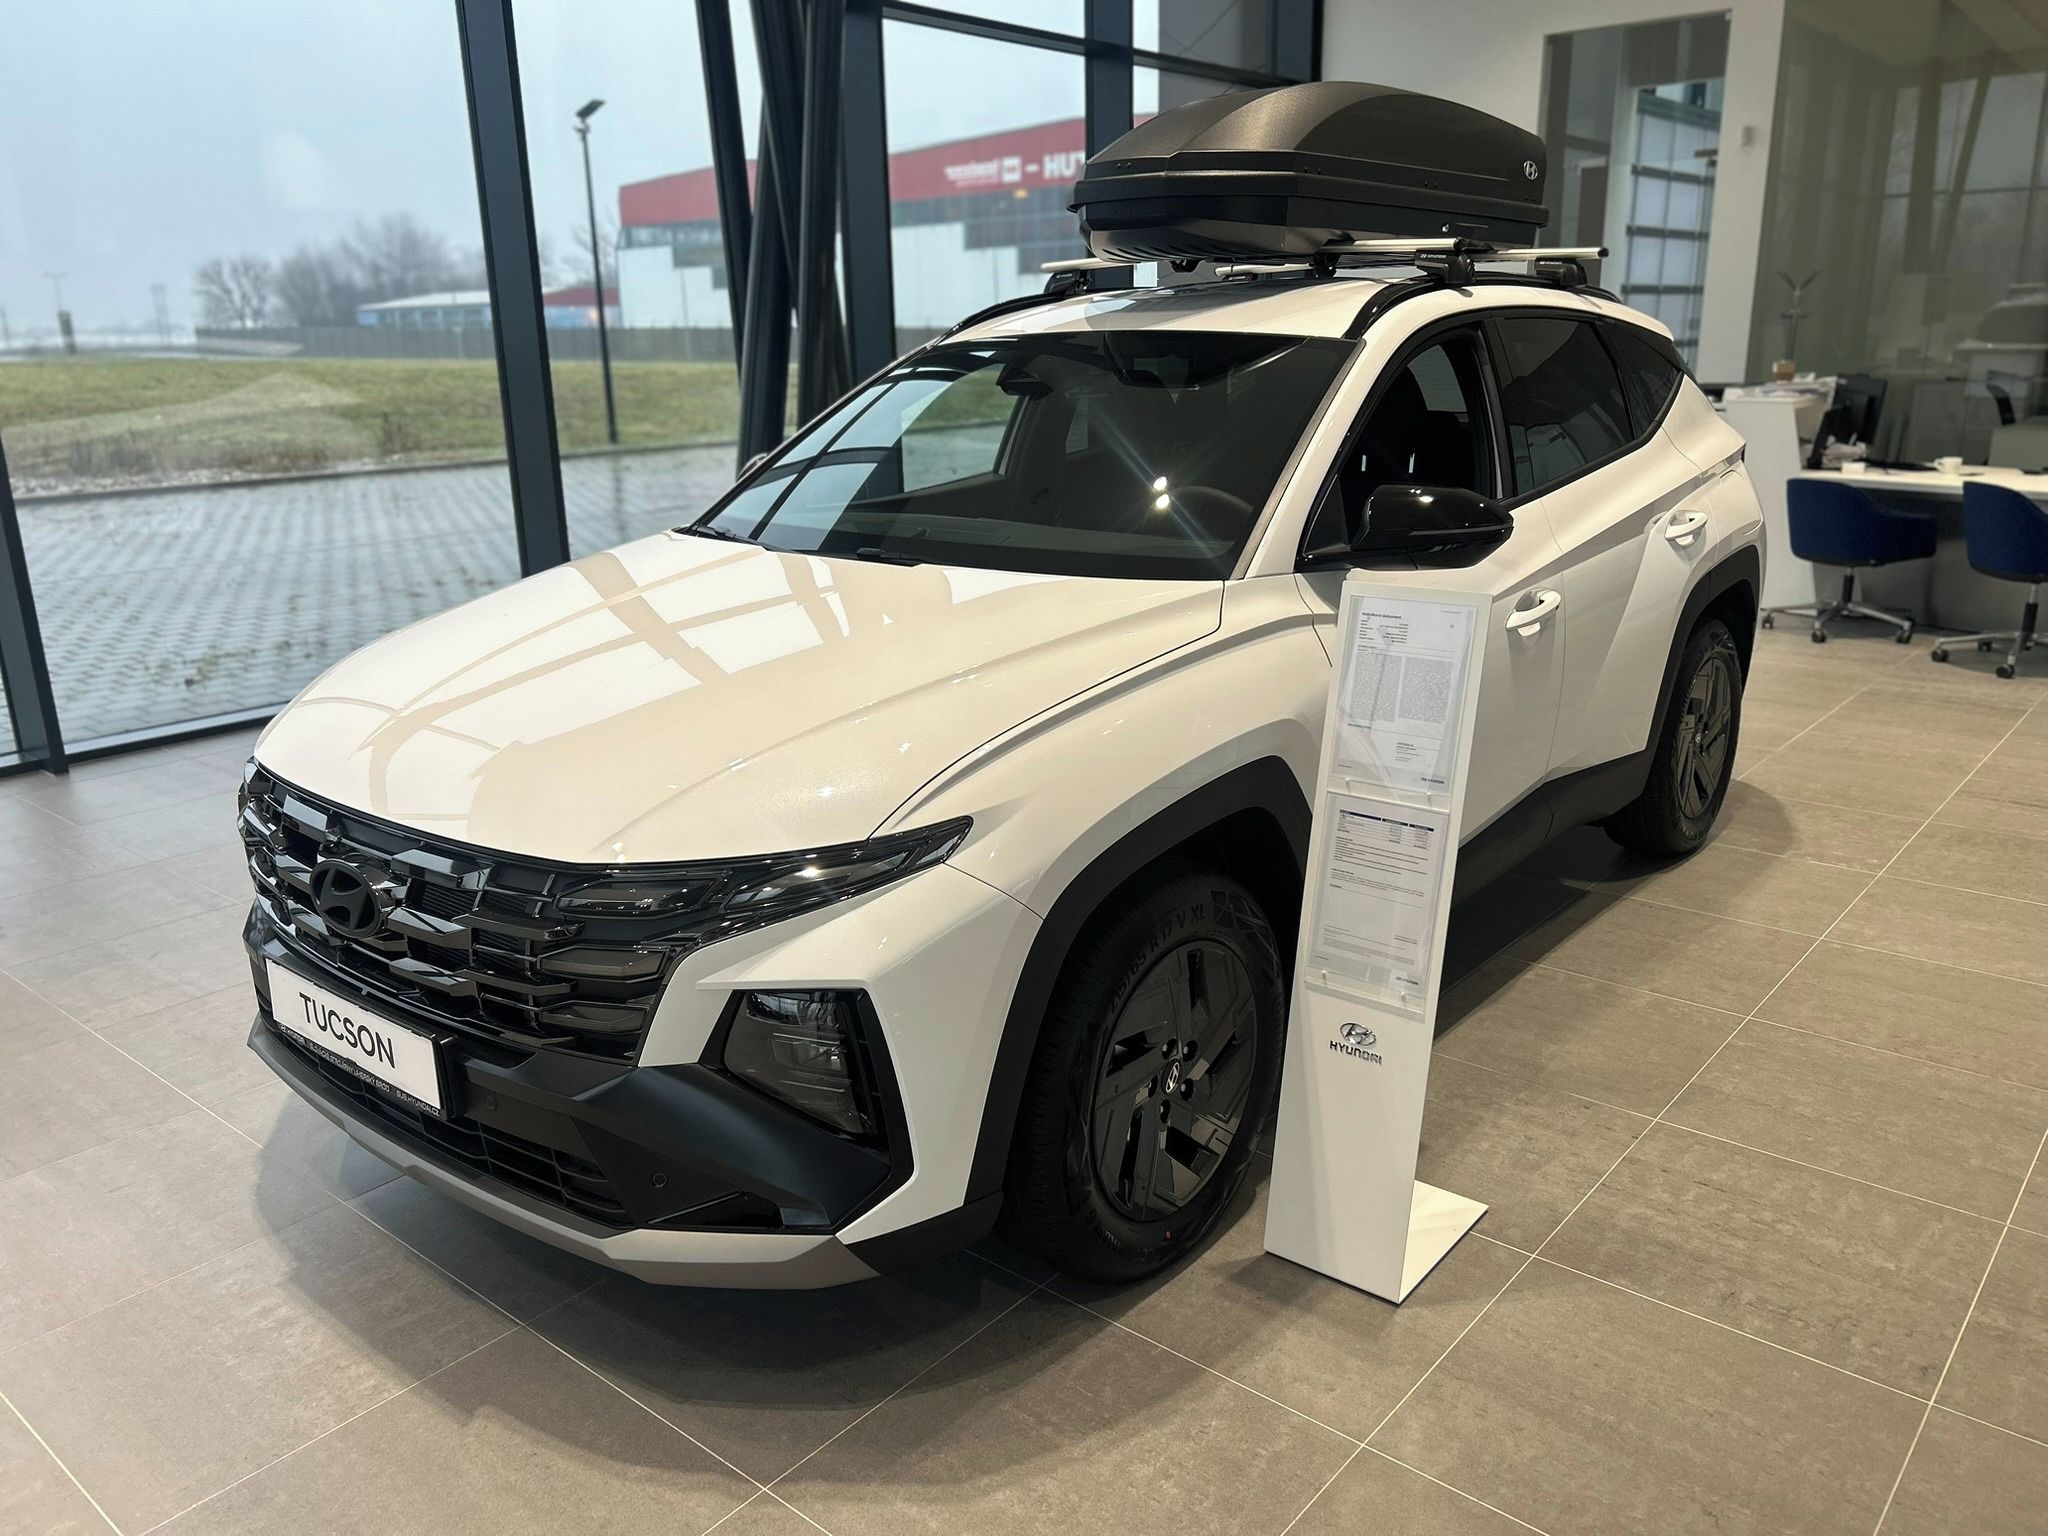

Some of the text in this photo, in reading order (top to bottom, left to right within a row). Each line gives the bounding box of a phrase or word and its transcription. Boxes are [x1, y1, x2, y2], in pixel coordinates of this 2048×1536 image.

[1191, 903, 1206, 922] XL
[299, 991, 395, 1069] TUCSON
[1329, 1040, 1382, 1065] HYUNDAI
